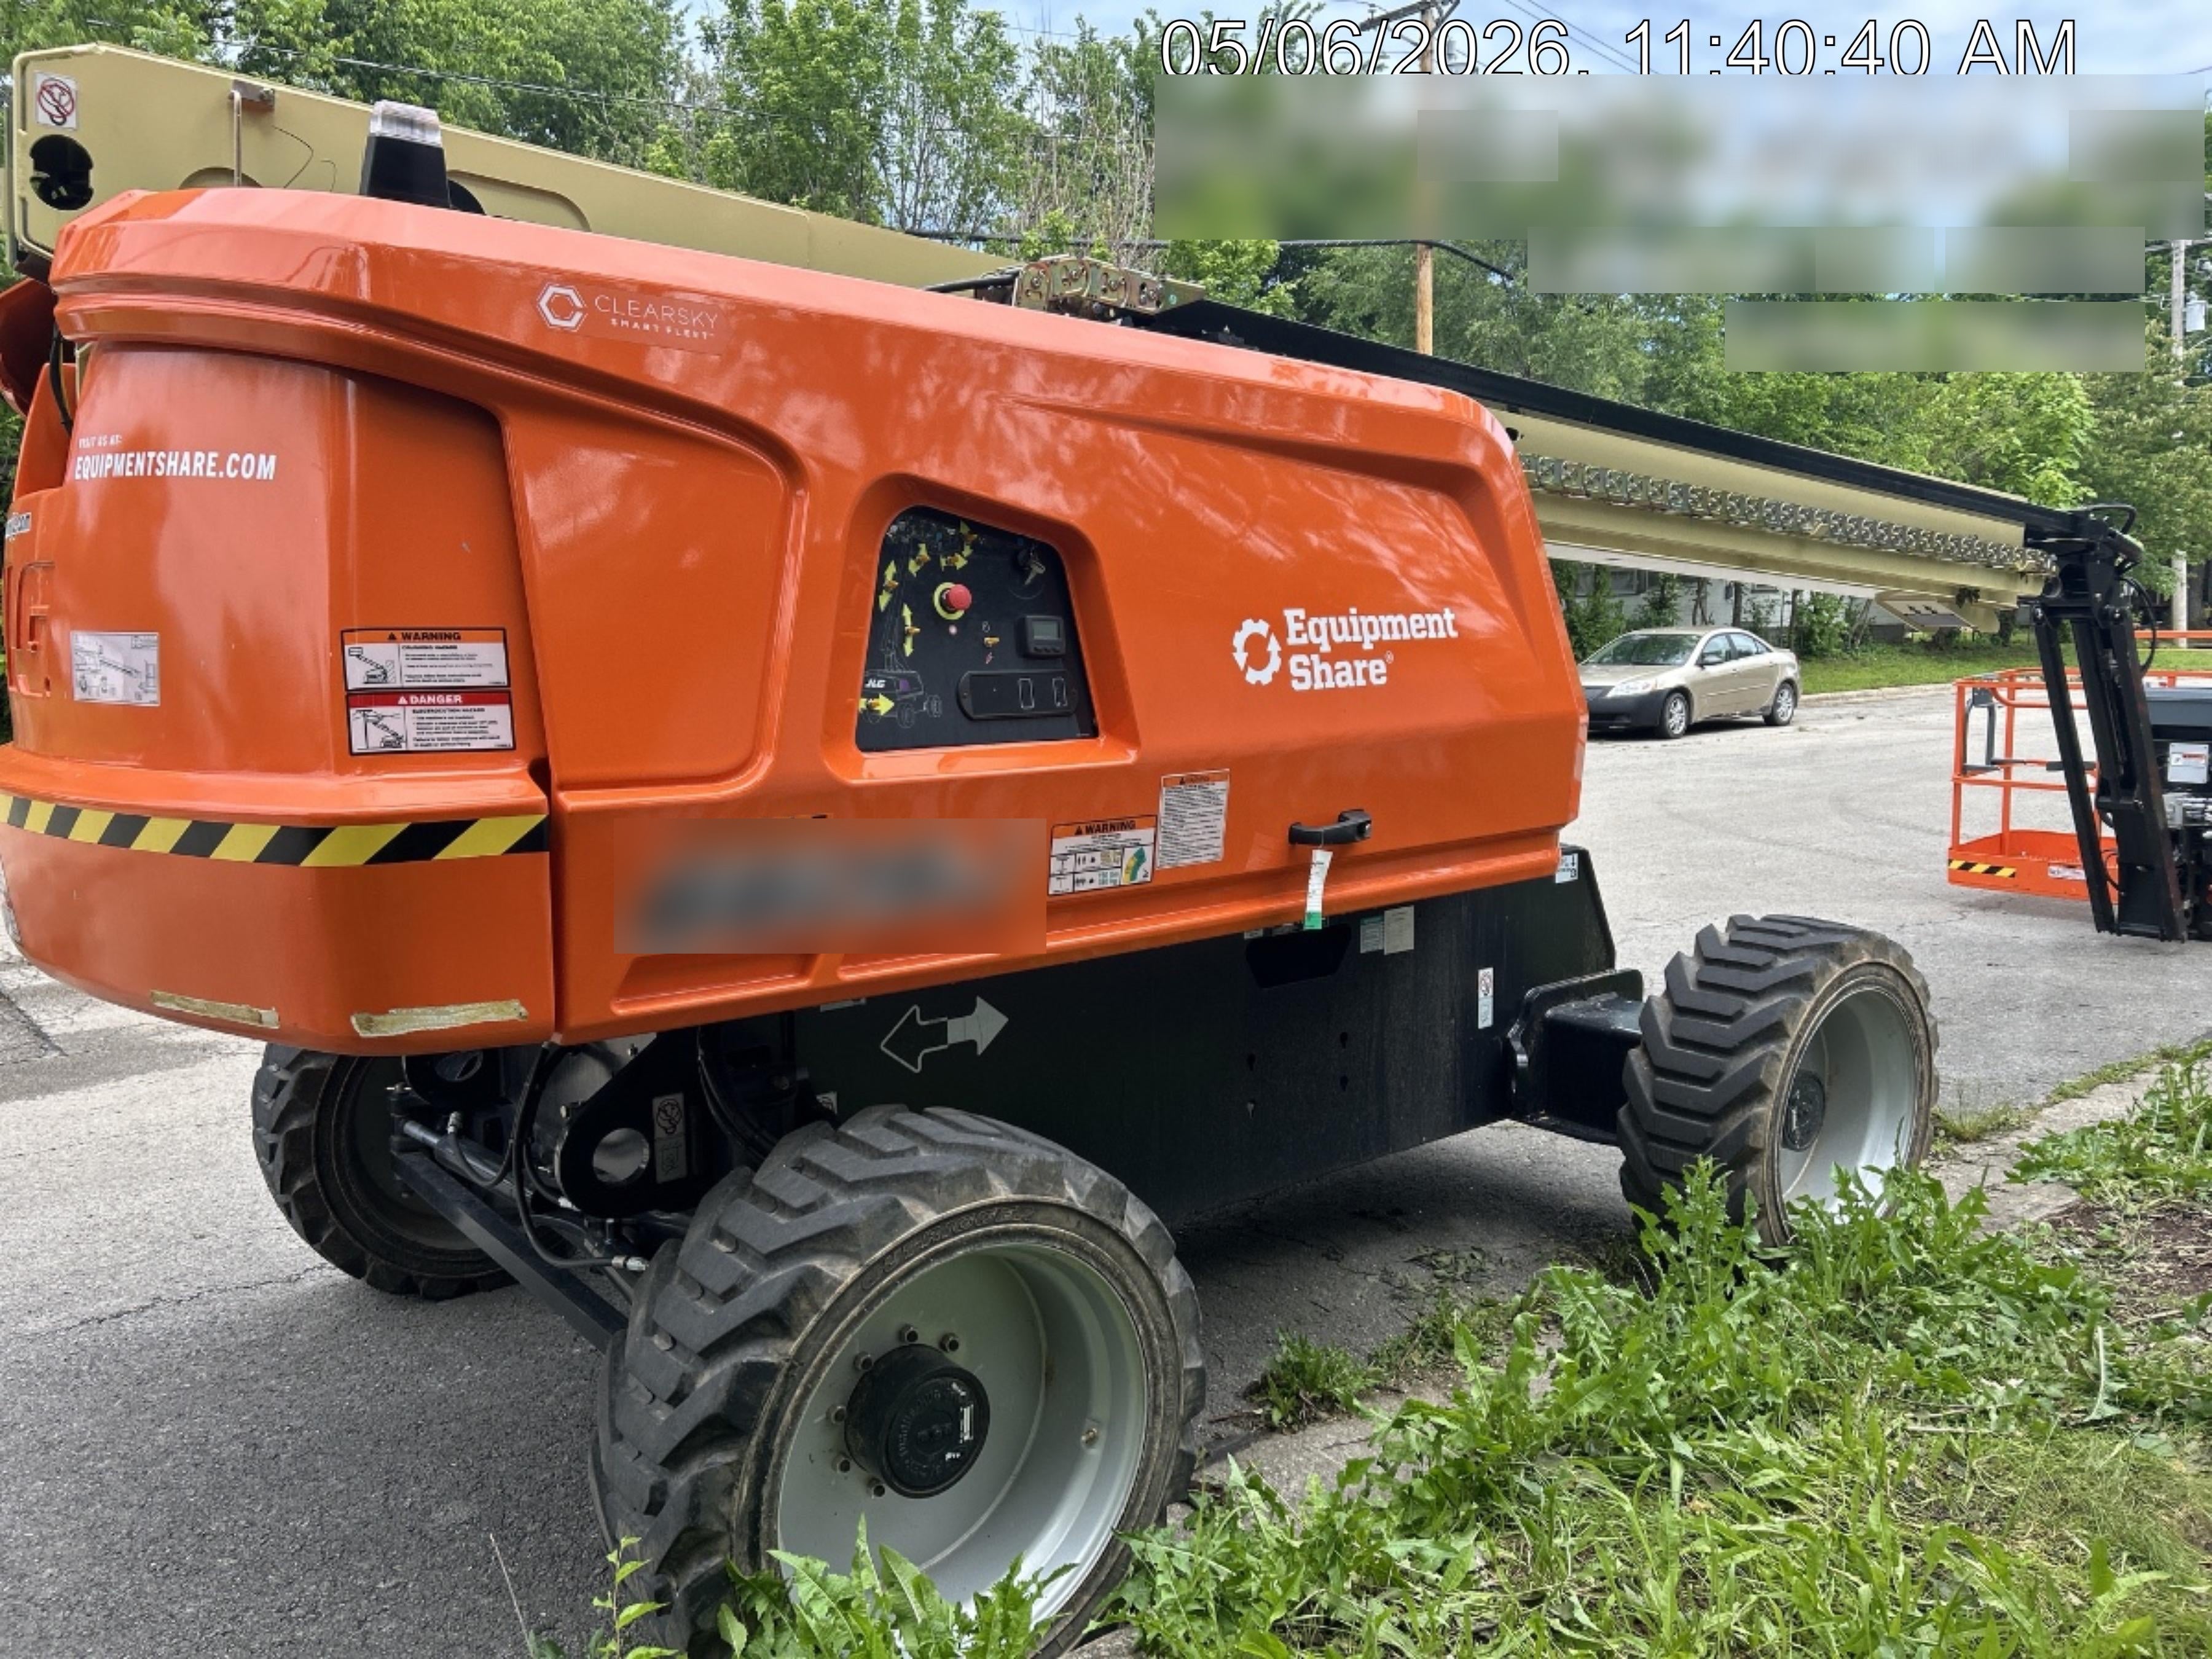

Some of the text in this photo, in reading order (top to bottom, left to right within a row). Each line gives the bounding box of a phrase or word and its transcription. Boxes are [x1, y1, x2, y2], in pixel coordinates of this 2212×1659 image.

[594, 294, 718, 329] CLEARSKY
[74, 451, 277, 482] EQUIPMENTSHARE.COM
[401, 632, 461, 641] WARNING
[1283, 607, 1459, 652] Equipment
[410, 694, 463, 705] DANGER
[1085, 820, 1136, 834] WARNING
